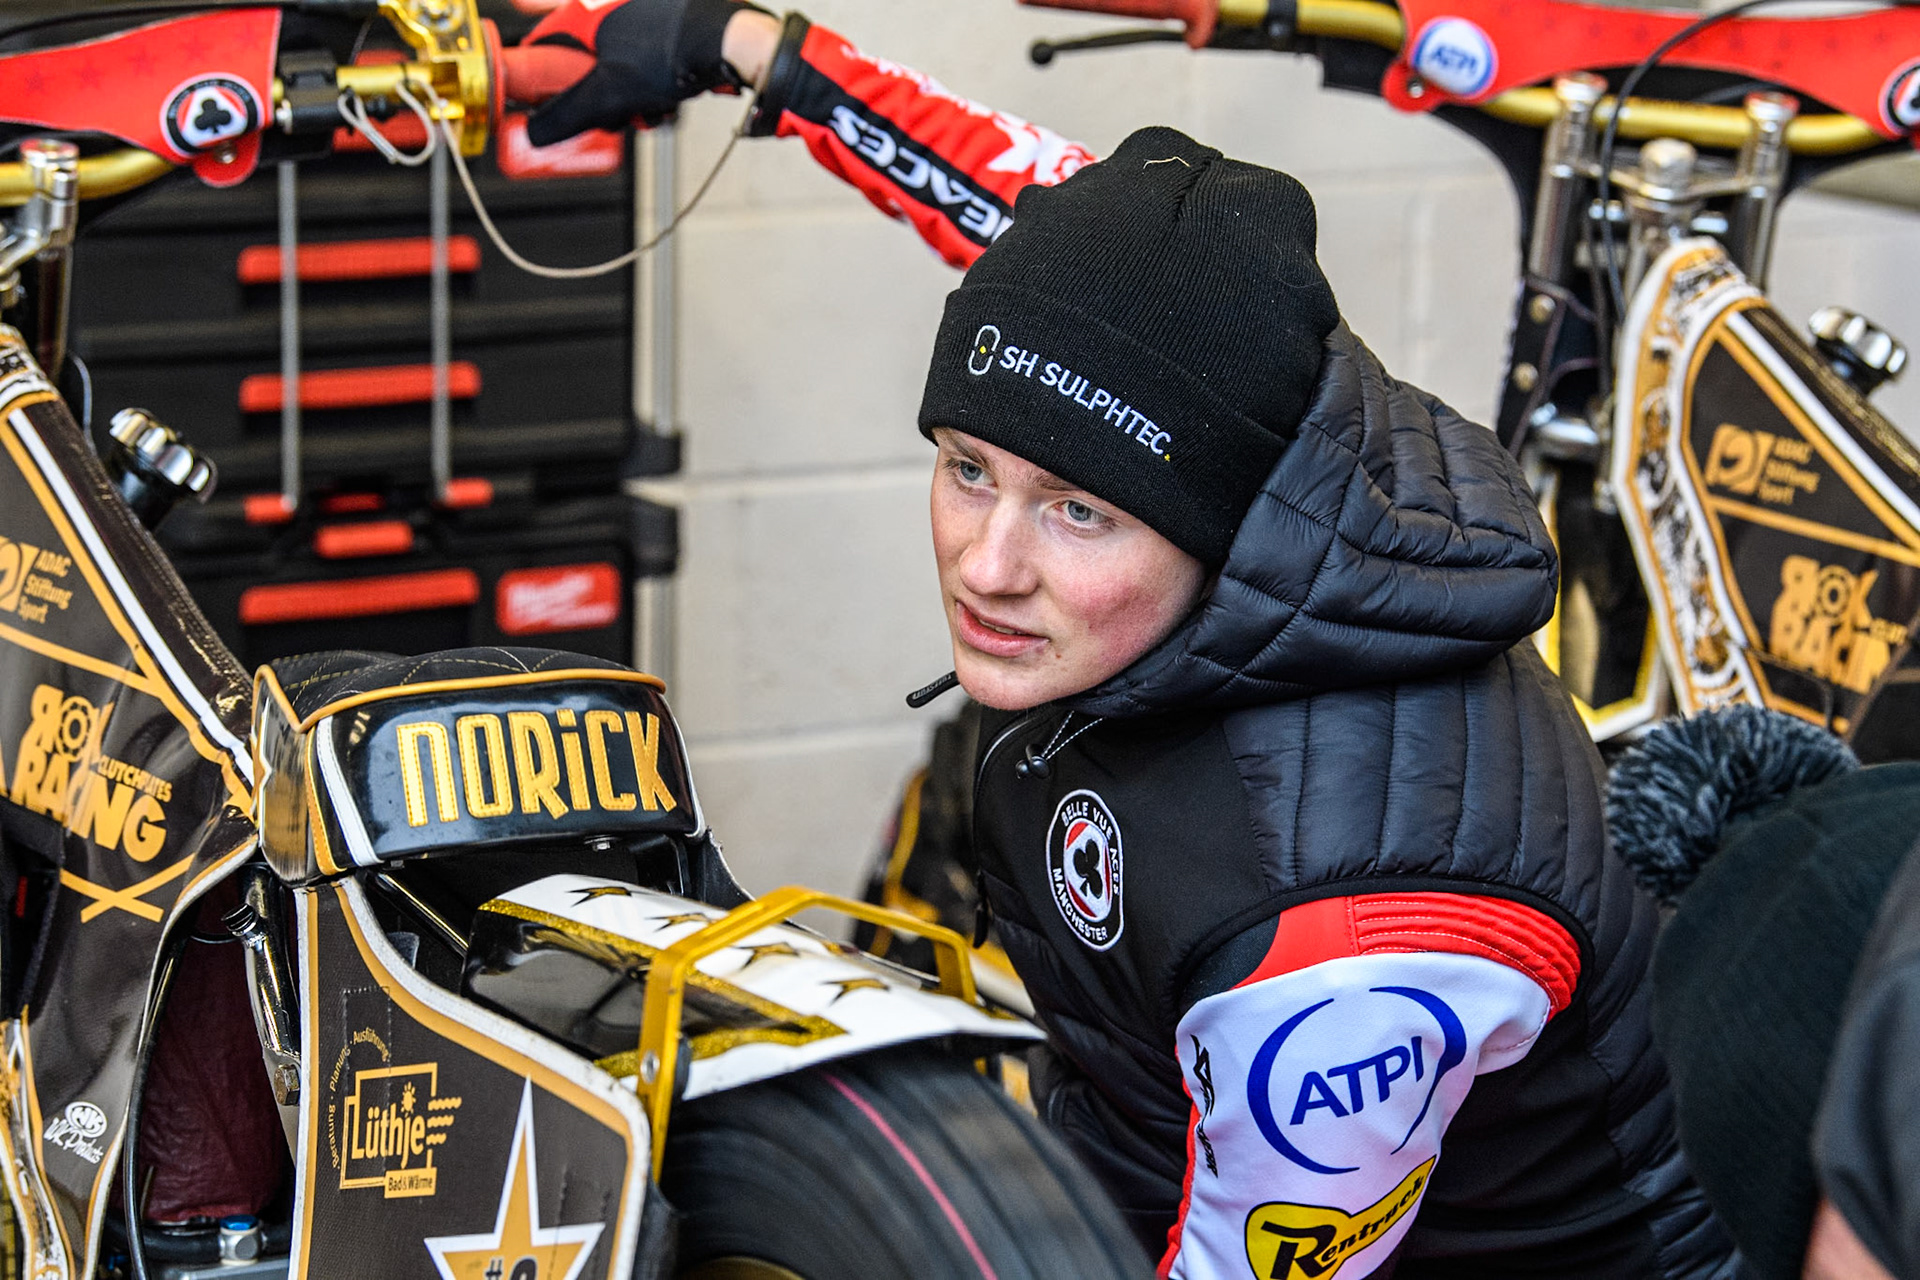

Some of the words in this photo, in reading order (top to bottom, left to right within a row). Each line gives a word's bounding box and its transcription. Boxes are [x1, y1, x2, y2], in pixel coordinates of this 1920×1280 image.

[1000, 345, 1040, 378] SH
[24, 574, 73, 610] Stiftung
[36, 549, 73, 578] ADAC
[18, 595, 48, 623] Sport
[1061, 802, 1089, 827] BELLE
[1092, 807, 1113, 840] VUE
[1109, 847, 1120, 895] ACES
[1052, 867, 1108, 941] MANCHESTER
[329, 1045, 351, 1092] Planung
[1289, 1035, 1425, 1126] ATPI
[351, 1102, 426, 1169] Lüthje
[1260, 1174, 1425, 1280] Rentruck
